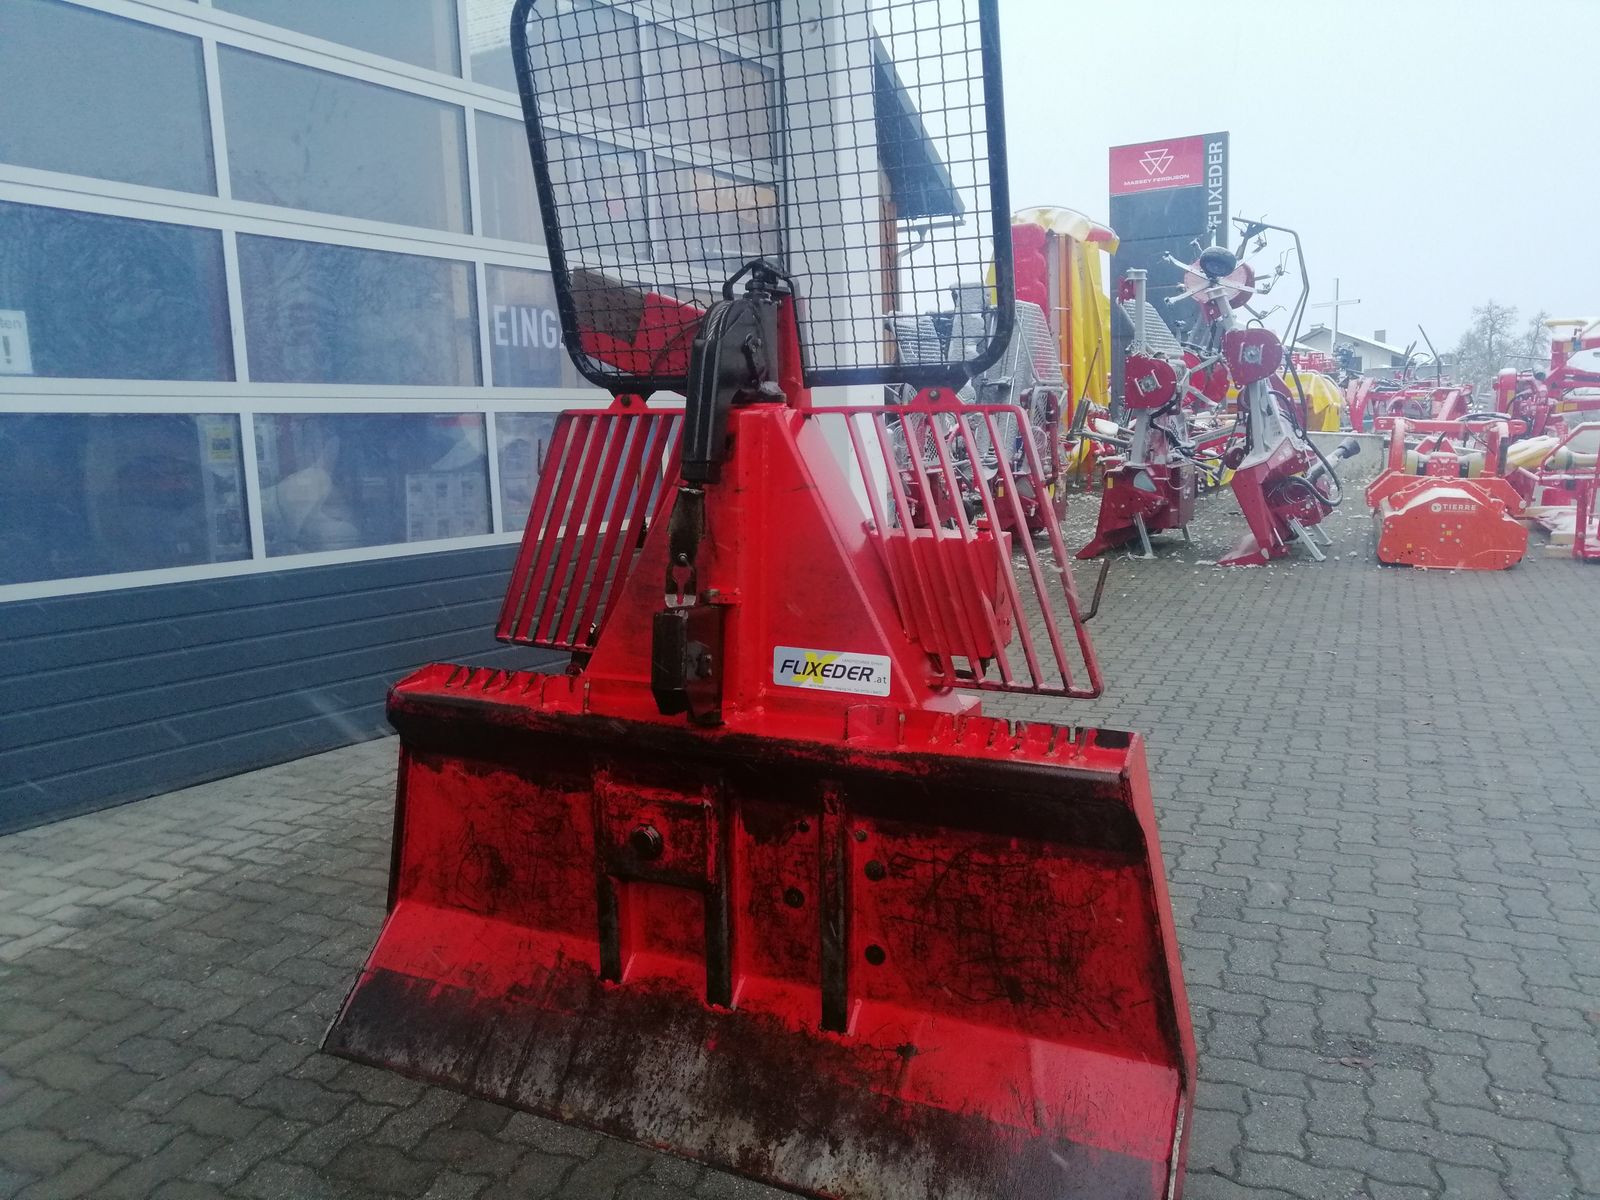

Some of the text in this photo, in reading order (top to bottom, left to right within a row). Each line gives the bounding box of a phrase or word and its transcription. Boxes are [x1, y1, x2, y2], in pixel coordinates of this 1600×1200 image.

[1124, 178, 1152, 186] MASSEY
[1208, 141, 1223, 225] FLIXEDER
[493, 305, 566, 349] EING
[1442, 503, 1477, 511] TIERRE
